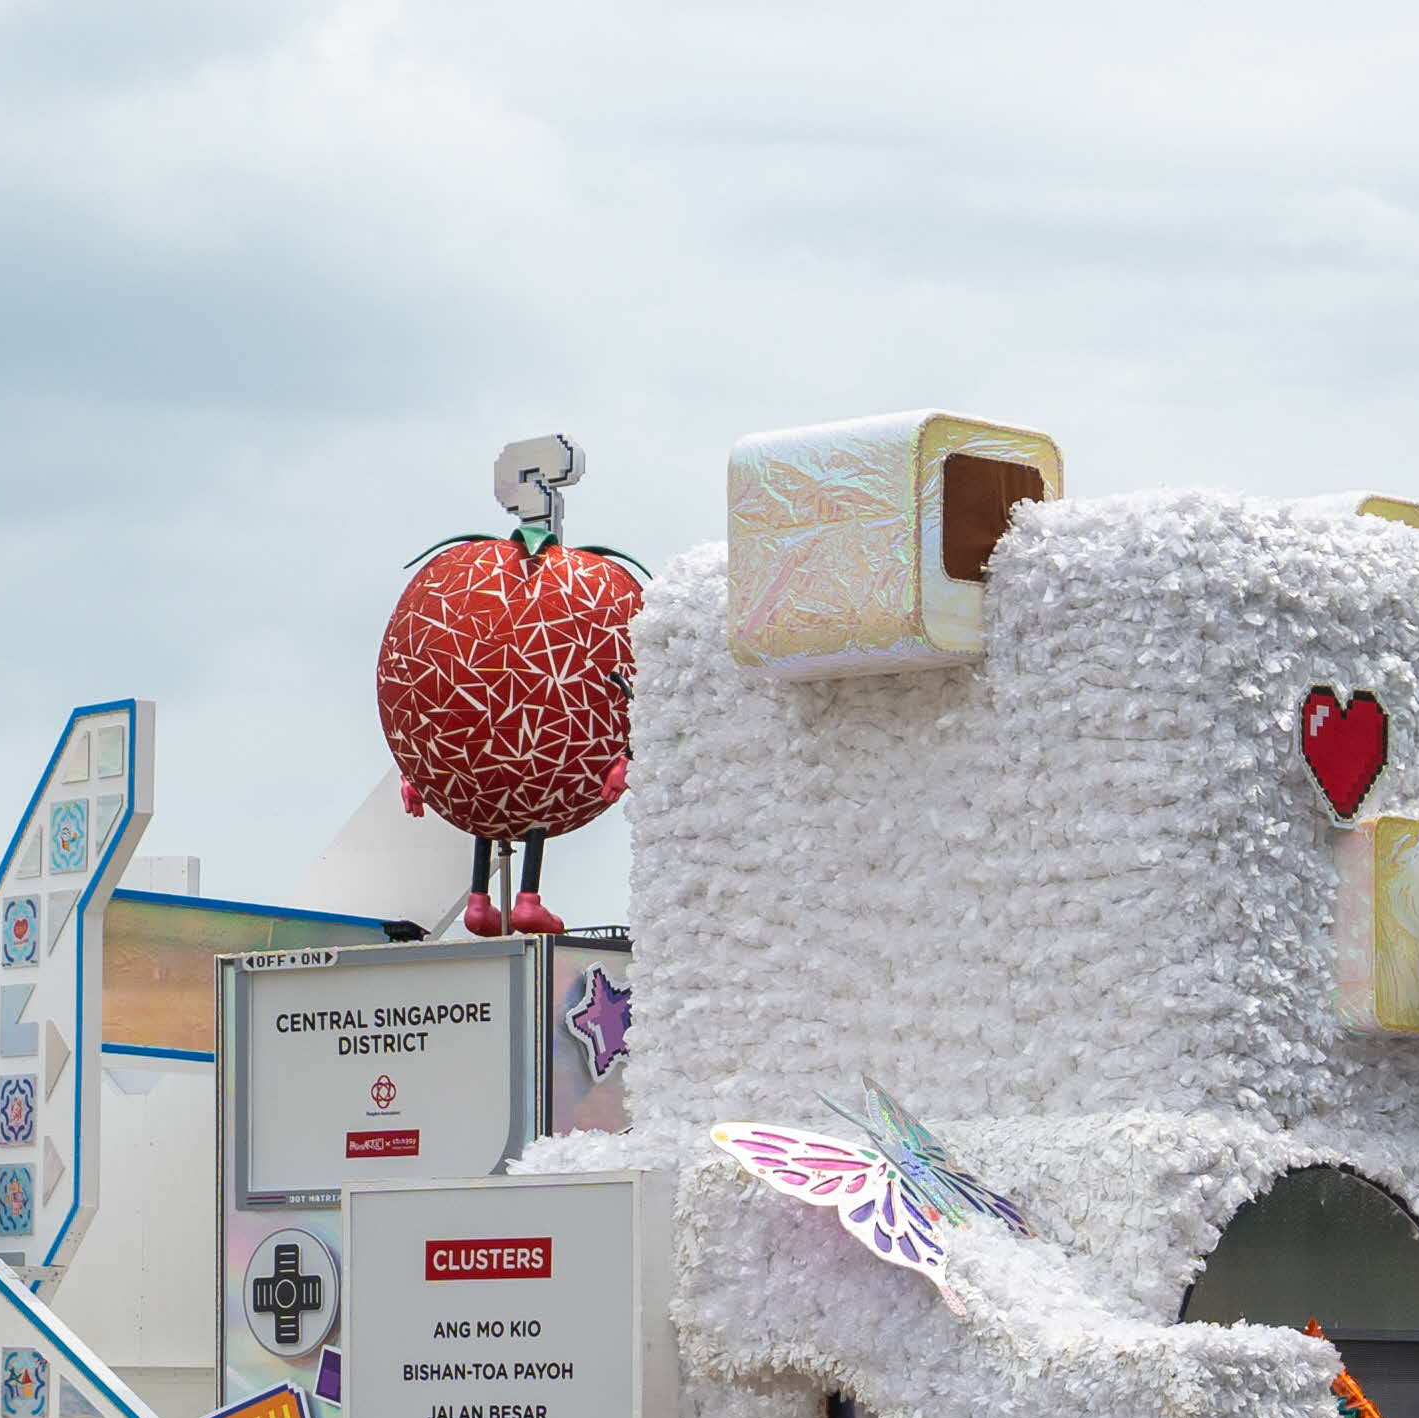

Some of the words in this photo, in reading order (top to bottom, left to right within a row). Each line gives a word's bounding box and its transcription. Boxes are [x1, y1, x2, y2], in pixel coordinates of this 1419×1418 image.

[256, 954, 286, 967] OFF
[301, 952, 320, 965] ON
[276, 1009, 368, 1033] CENTRAL
[374, 1003, 491, 1028] SINGAPORE
[338, 1032, 428, 1055] DISTRICT
[433, 1246, 544, 1271] CLUSTERS
[434, 1321, 471, 1339] ANG
[476, 1321, 504, 1338] MO
[510, 1320, 541, 1337] KIO
[403, 1364, 508, 1381] BISHAN-TOA
[514, 1363, 573, 1380] PAYOH
